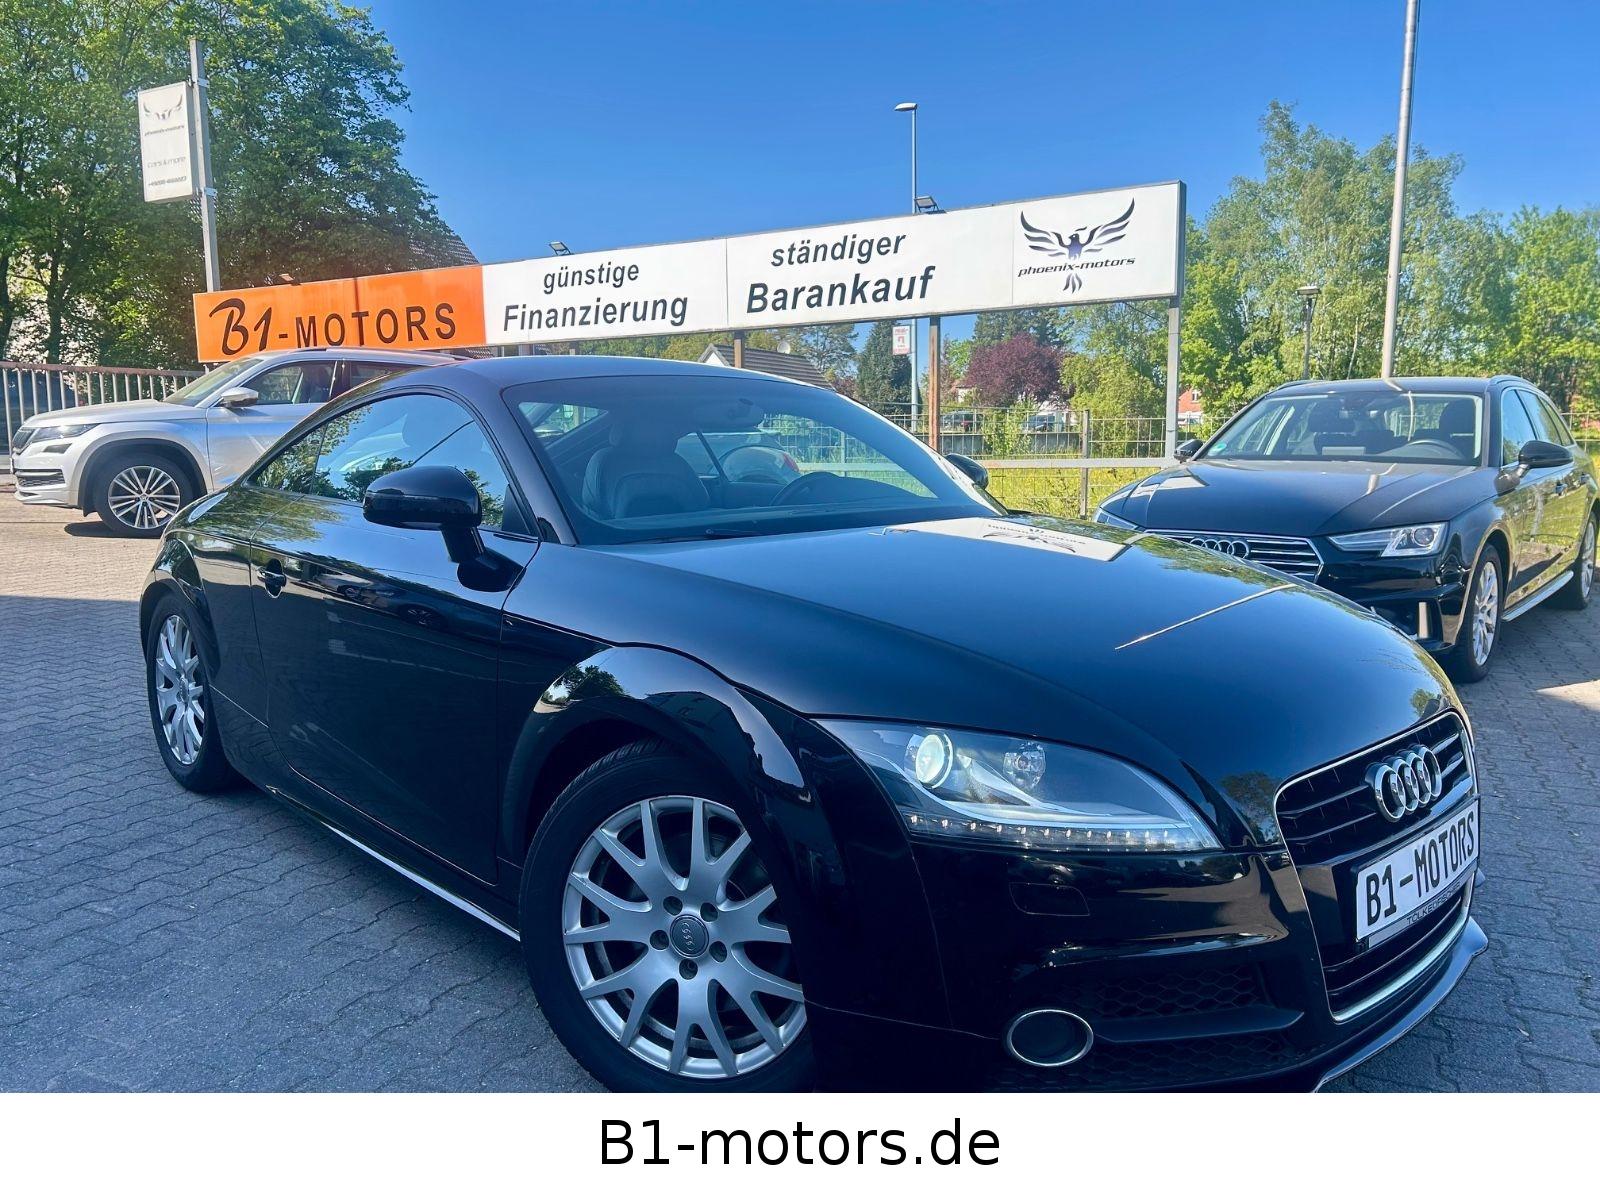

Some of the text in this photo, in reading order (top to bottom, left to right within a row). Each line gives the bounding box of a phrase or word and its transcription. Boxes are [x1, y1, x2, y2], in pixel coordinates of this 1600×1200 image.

[771, 233, 906, 266] ständiger
[543, 261, 639, 295] günstige
[1017, 257, 1136, 278] phoenix-motors
[746, 265, 936, 314] Barankauf
[208, 298, 457, 355] B1-MOTORS
[503, 297, 688, 332] Finanzierung
[1366, 810, 1474, 927] B1-MOTORS
